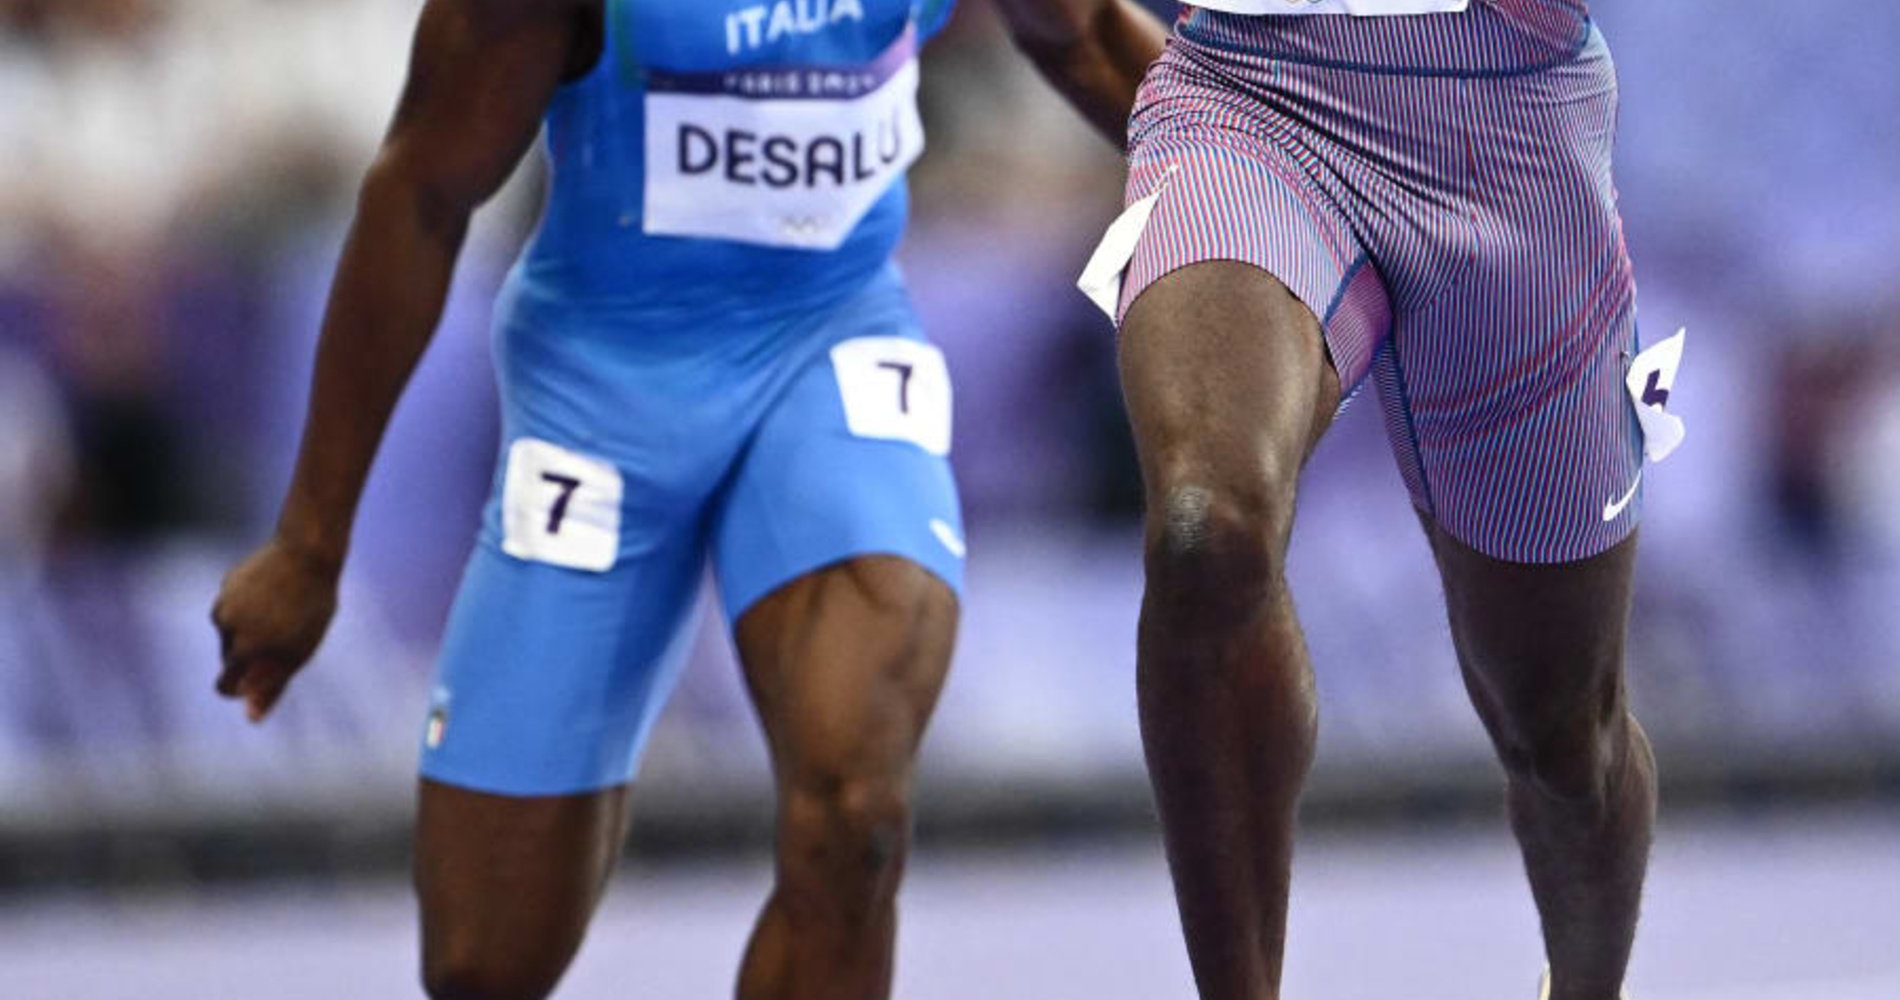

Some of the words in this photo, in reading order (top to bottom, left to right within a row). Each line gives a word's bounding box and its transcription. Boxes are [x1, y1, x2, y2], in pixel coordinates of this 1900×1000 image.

[677, 107, 900, 189] DESALU
[878, 362, 912, 414] 7
[541, 472, 580, 534] 7
